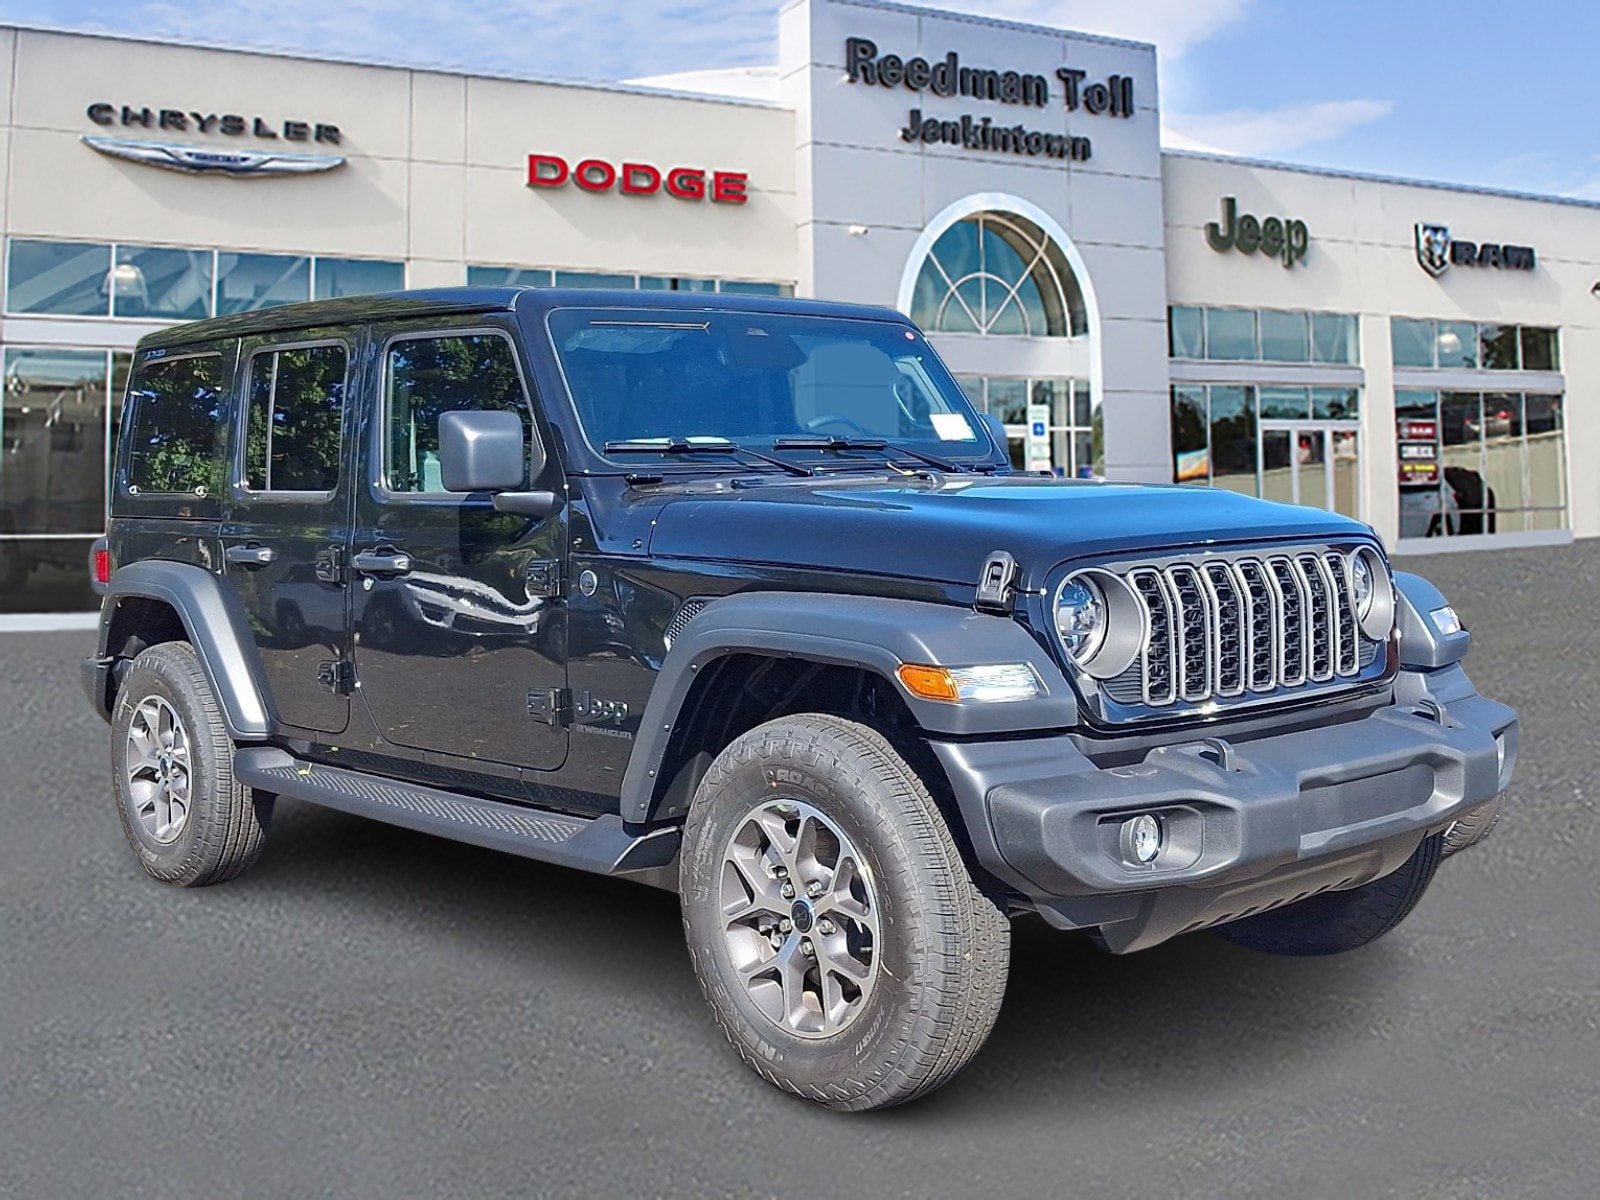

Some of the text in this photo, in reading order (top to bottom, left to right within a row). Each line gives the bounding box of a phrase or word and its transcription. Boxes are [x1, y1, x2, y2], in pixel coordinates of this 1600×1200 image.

[845, 36, 1135, 119] Reedman Toll
[86, 102, 342, 145] CHRYSLER
[900, 108, 1093, 162] Jenkintown
[526, 153, 749, 204] DODGE
[1204, 196, 1308, 269] Jeep
[1450, 240, 1536, 270] RAM
[576, 690, 628, 726] Jeep
